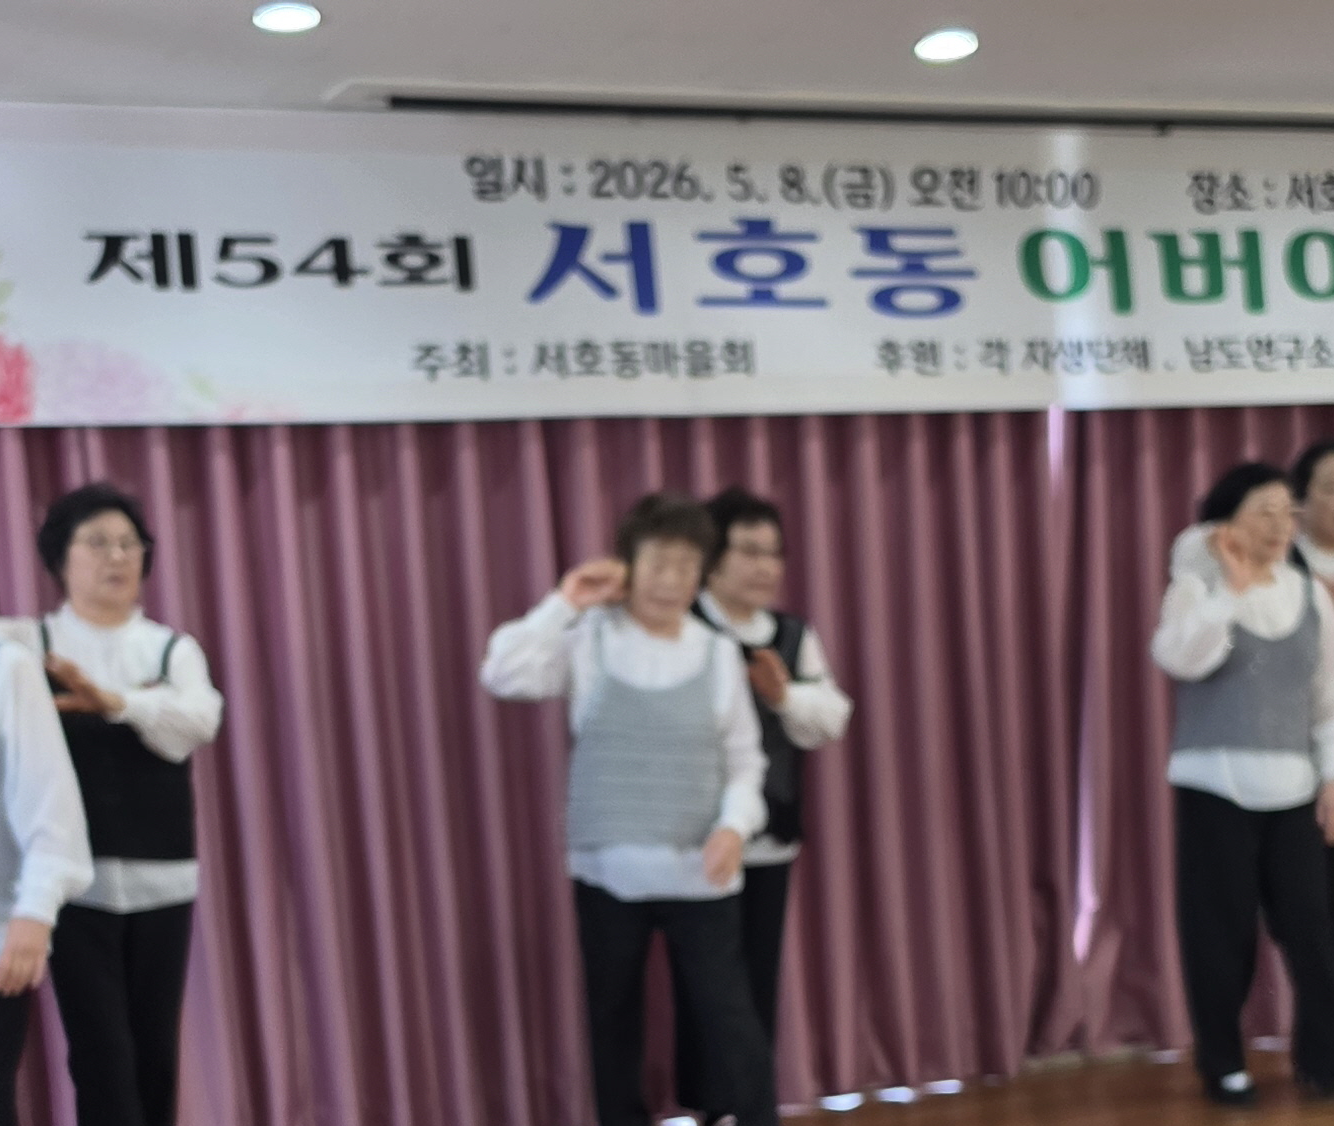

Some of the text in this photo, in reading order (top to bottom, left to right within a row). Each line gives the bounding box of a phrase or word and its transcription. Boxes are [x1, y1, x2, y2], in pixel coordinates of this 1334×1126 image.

[464, 155, 548, 203] 일시
[587, 159, 714, 202] 2026.
[725, 162, 767, 203] 5.
[909, 165, 986, 212] 오전
[993, 167, 1101, 210] 10:00
[1186, 170, 1255, 216] 장소
[83, 231, 478, 291] 제54회
[525, 217, 979, 318] 서호동
[410, 340, 493, 382] 주최
[531, 338, 758, 380] 서호동마을회
[876, 337, 944, 377] 후원
[977, 337, 1011, 377] 각
[1021, 337, 1152, 377] 자생단체
